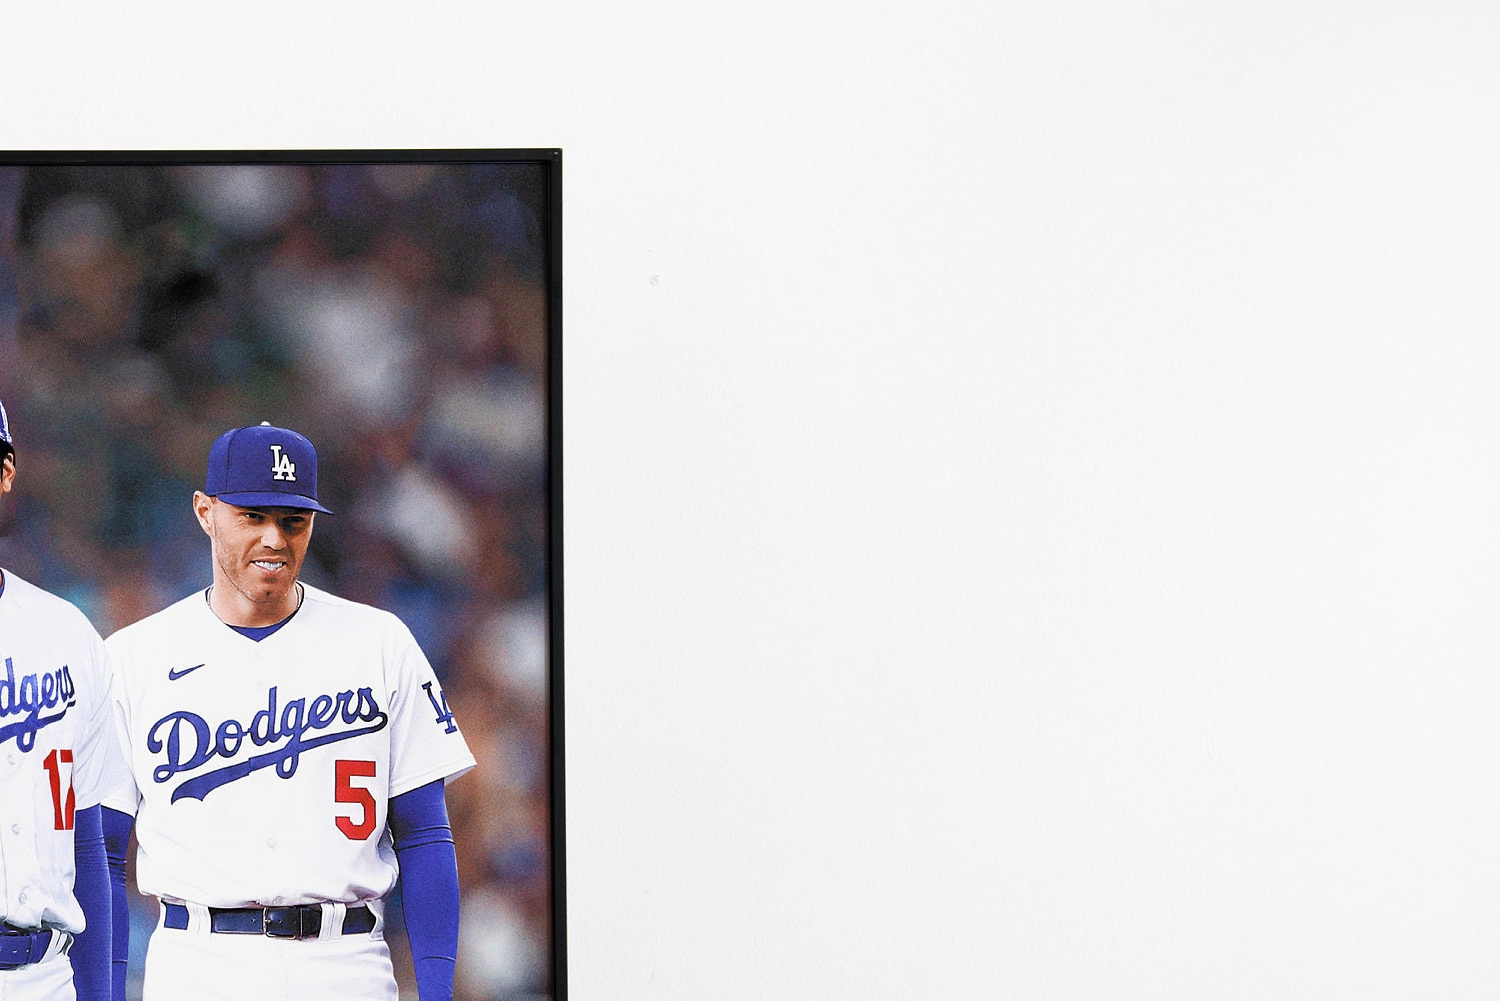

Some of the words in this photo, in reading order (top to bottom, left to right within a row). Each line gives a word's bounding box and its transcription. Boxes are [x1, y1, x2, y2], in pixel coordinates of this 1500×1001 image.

[269, 445, 297, 482] LA
[147, 685, 389, 783] Dodgers
[42, 748, 76, 831] 17
[334, 759, 377, 841] 5
